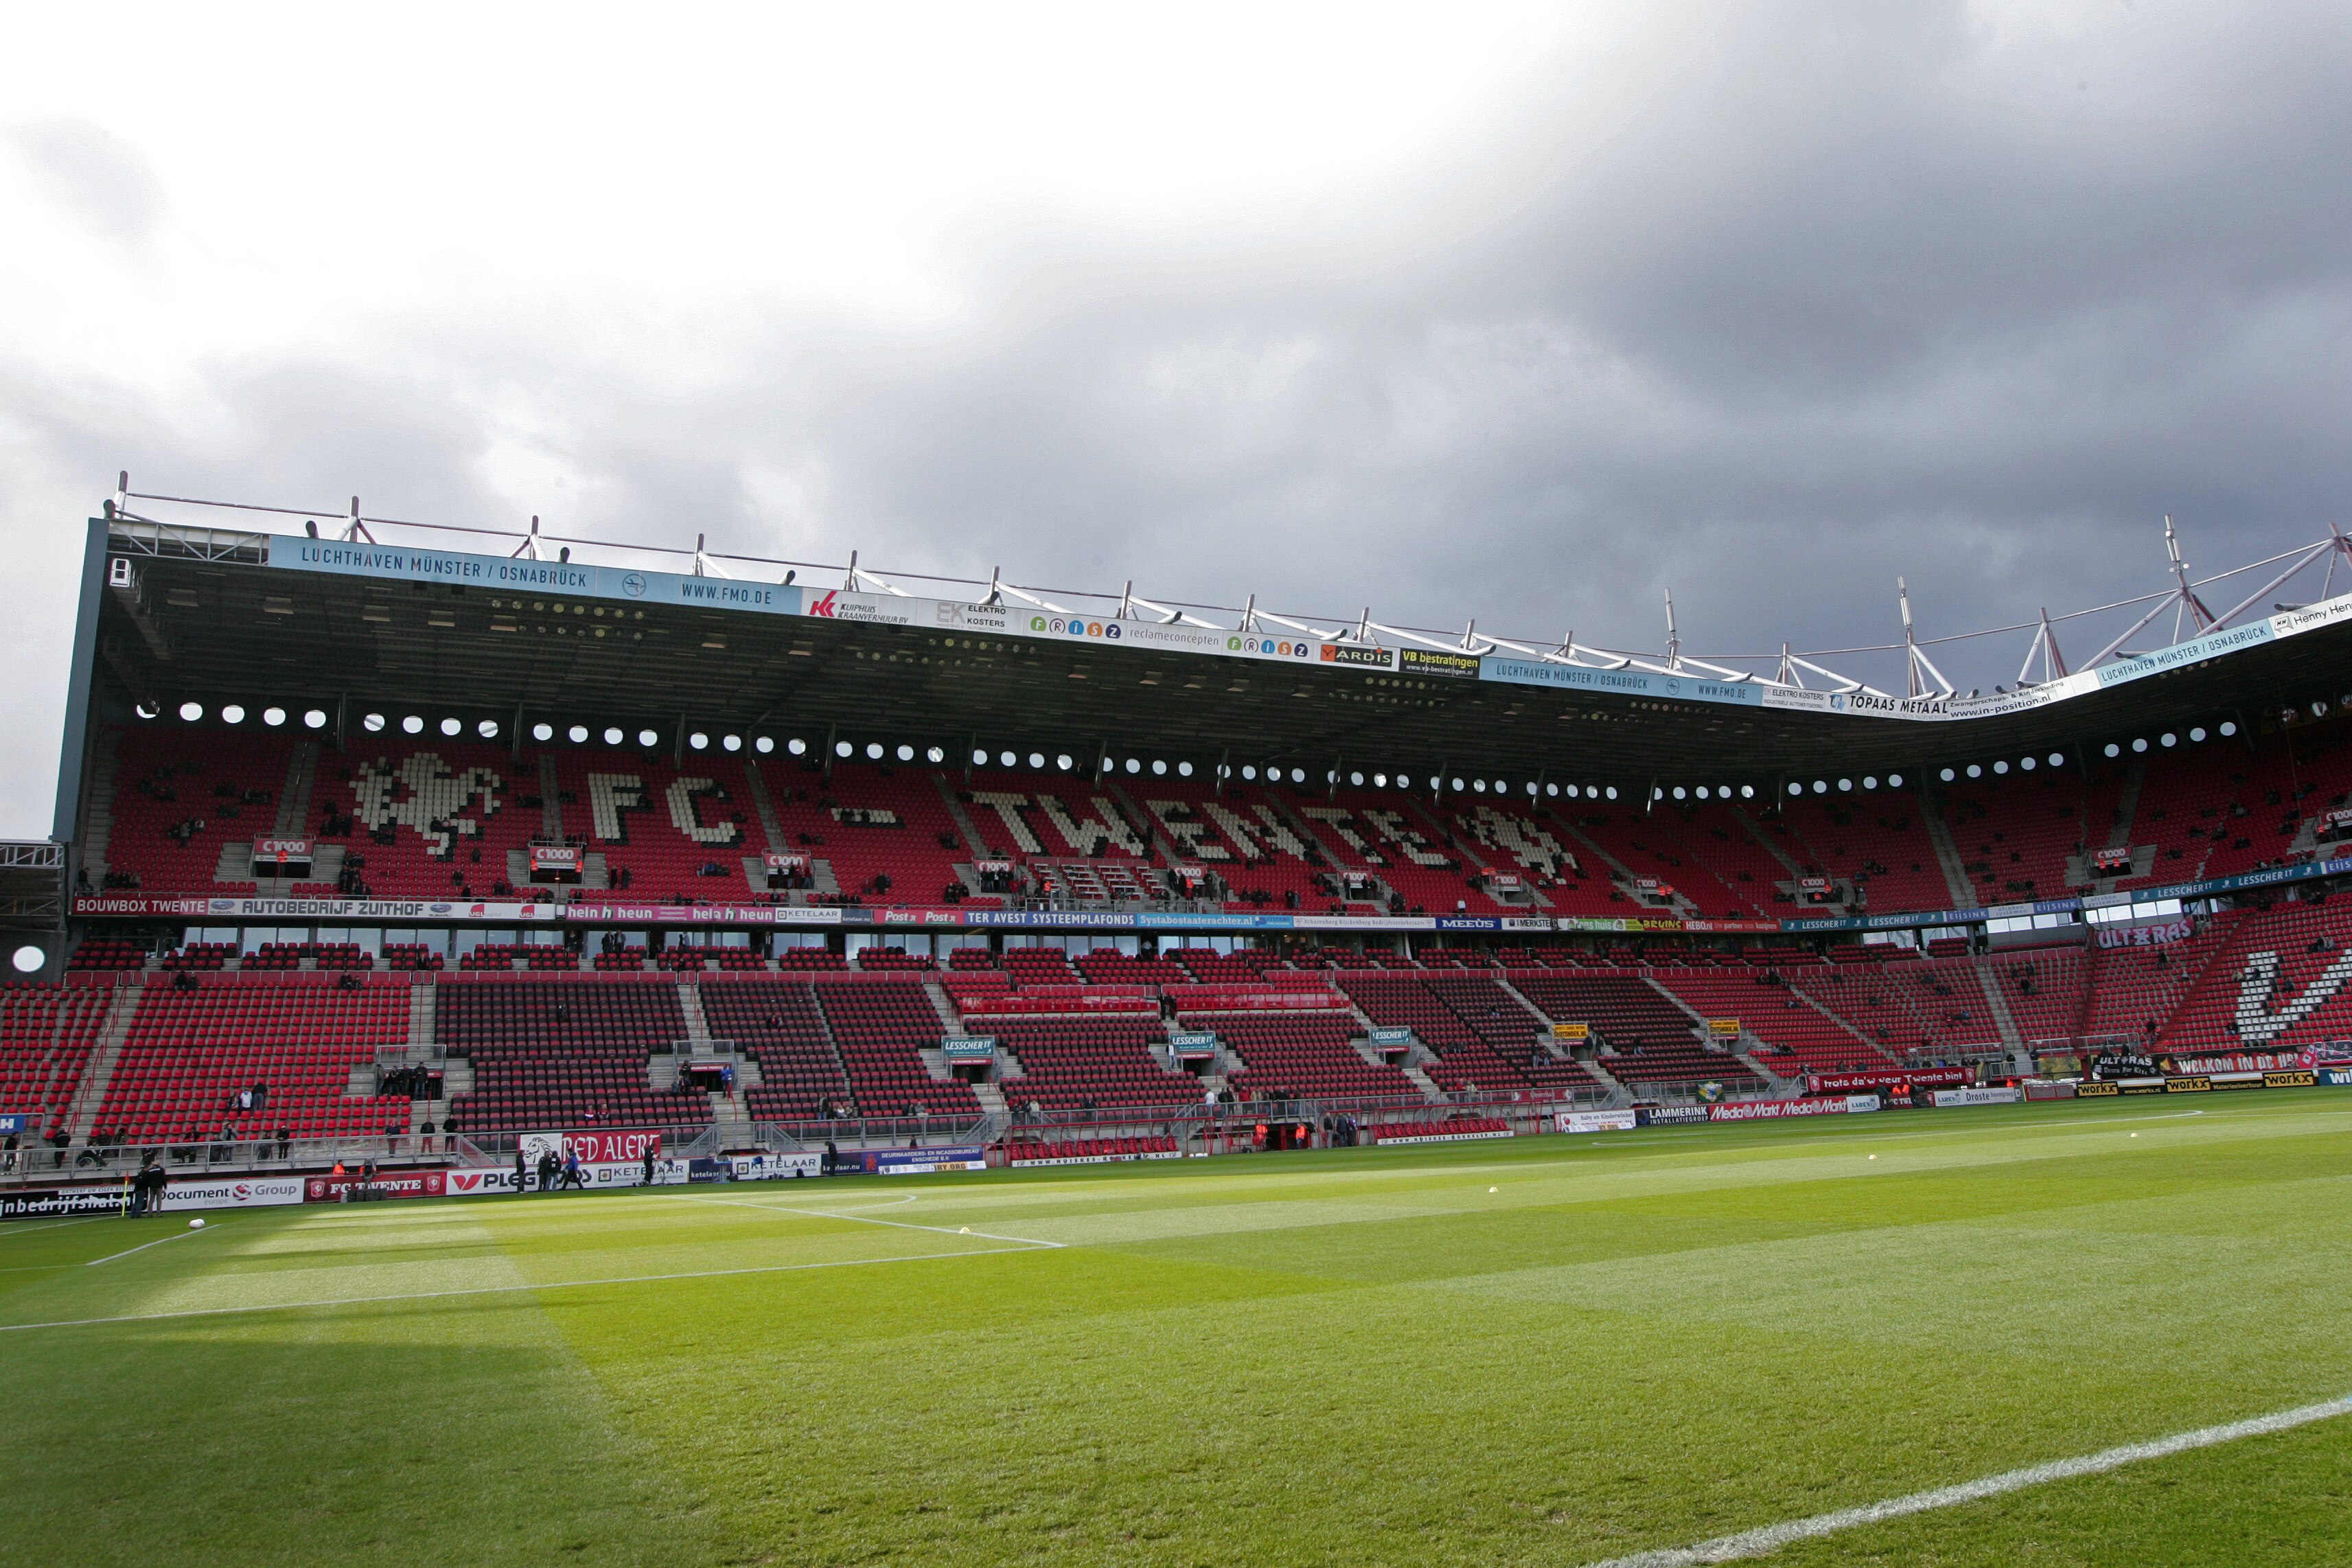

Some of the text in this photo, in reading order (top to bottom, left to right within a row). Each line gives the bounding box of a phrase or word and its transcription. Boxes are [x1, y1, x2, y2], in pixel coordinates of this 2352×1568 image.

[302, 547, 403, 570] LUCHTHAVEN
[411, 559, 481, 578] MÜNSTER
[499, 566, 586, 587] OSNABRÜCK
[682, 583, 771, 605] WWW.FMO.DE
[968, 605, 1006, 614] ELEKTRO
[967, 618, 1005, 627] KOSTERS
[2294, 610, 2327, 625] Henny
[1130, 627, 1219, 645] reclameconcepten
[1403, 651, 1478, 668] VB bestratingen
[2101, 653, 2156, 682] LUCHTHAVEN
[2157, 645, 2200, 669] MÜNSTER
[2208, 626, 2267, 651] OSNABRÜCK
[1497, 665, 1550, 679] LUCHTHAVEN
[1554, 669, 1591, 684] MÜNSTER
[1601, 676, 1648, 689] OSNABRÜCK
[1698, 685, 1746, 699] WWW.FMO.DE
[1772, 689, 1798, 698] ELEKTRO
[1799, 692, 1824, 700] KOSTERS
[1849, 695, 1895, 711] TOPAAS
[1900, 701, 1948, 713] METAAL
[1950, 693, 2051, 717] www.in-position.nl
[263, 840, 305, 853] C1000
[536, 849, 574, 860] C1000
[2097, 849, 2125, 859] C1000
[1495, 876, 1517, 884] C1000
[2239, 869, 2294, 886] LESSCHER IT
[2158, 882, 2213, 897] LESSCHER IT
[77, 899, 205, 912] BOUWBOX TWENTE
[242, 901, 353, 916] AUTOBEDRIJF
[358, 902, 424, 915] ZUITHOF
[568, 907, 597, 918] hein
[618, 907, 652, 919] heun
[740, 908, 772, 920] heun
[885, 912, 908, 921] Post
[925, 912, 949, 921] Post
[968, 913, 1134, 924] TER AVEST SYSTEEMPLAFONDS
[1595, 920, 1612, 930] huis
[1643, 920, 1681, 928] BRUINS
[1686, 921, 1714, 930] HEBO.nl
[1801, 921, 1838, 929] LESSCHER
[1868, 917, 1910, 926] LESSCHER
[945, 1041, 982, 1050] LESSCHER
[2237, 1056, 2253, 1070] IN
[1824, 1078, 1848, 1088] trots
[1878, 1076, 1901, 1085] veur
[1904, 1074, 1943, 1084] Twente
[2167, 1079, 2209, 1090] workx
[2079, 1083, 2114, 1094] workx
[1966, 1092, 1990, 1102] Droste
[1650, 1106, 1709, 1119] LAMMERINK
[1711, 1103, 1780, 1120] Media Markt
[1782, 1098, 1847, 1115] Media Markt
[562, 1137, 599, 1162] RED
[255, 1185, 297, 1197] Group
[330, 1183, 351, 1194] FC
